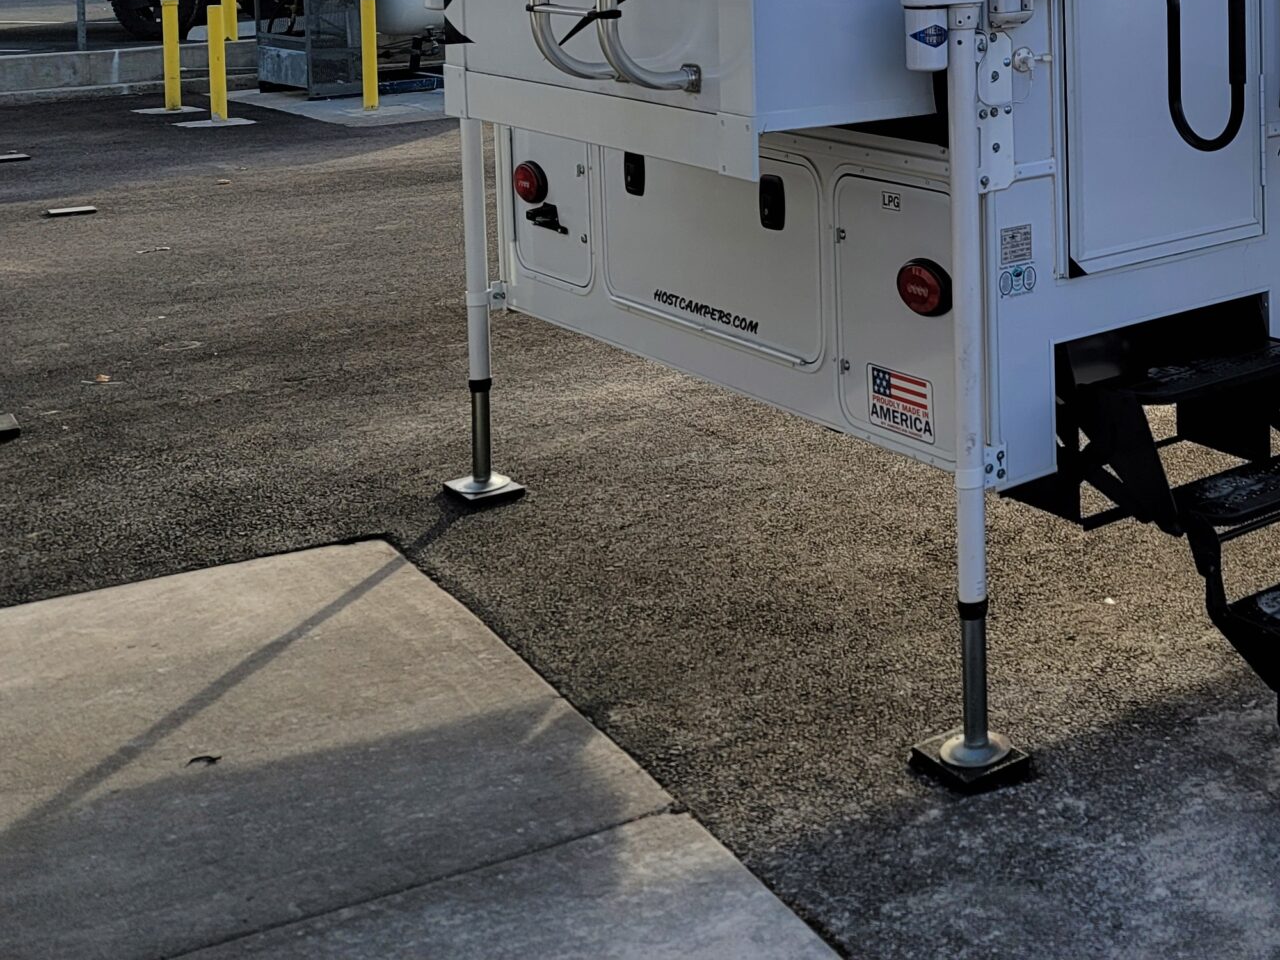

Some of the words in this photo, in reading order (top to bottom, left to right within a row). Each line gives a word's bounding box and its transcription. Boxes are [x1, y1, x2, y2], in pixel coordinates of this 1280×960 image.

[882, 194, 900, 208] LPG
[653, 289, 759, 334] HOSTCAMPERS.COM
[871, 403, 933, 437] AMERICA
[872, 394, 900, 410] PROUDLY
[901, 403, 921, 417] MADE
[922, 411, 929, 419] IN
